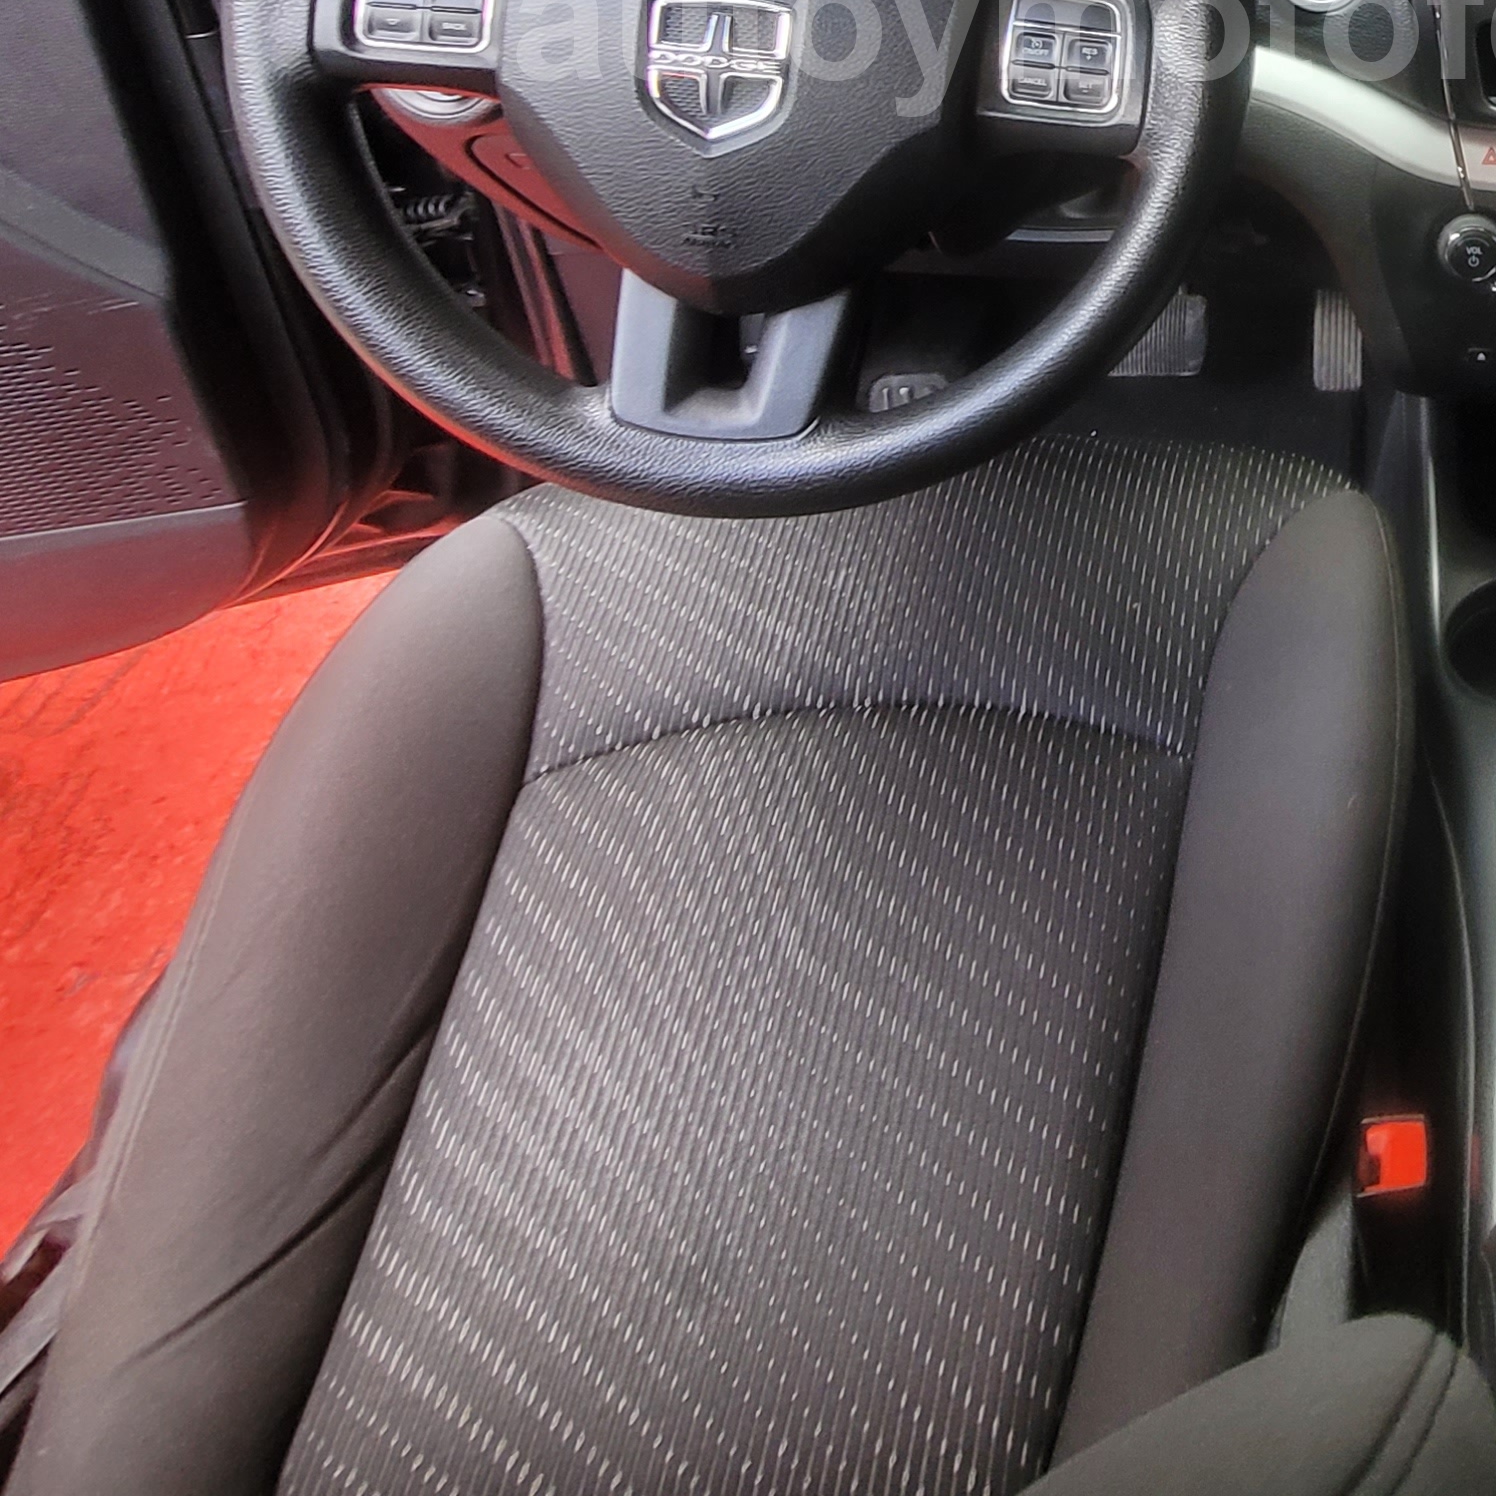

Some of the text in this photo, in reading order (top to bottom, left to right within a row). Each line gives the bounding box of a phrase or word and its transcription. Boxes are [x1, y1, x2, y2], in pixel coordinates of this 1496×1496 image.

[649, 51, 782, 74] DODGE
[1019, 76, 1048, 86] CANCEL
[1466, 246, 1483, 255] VOL
